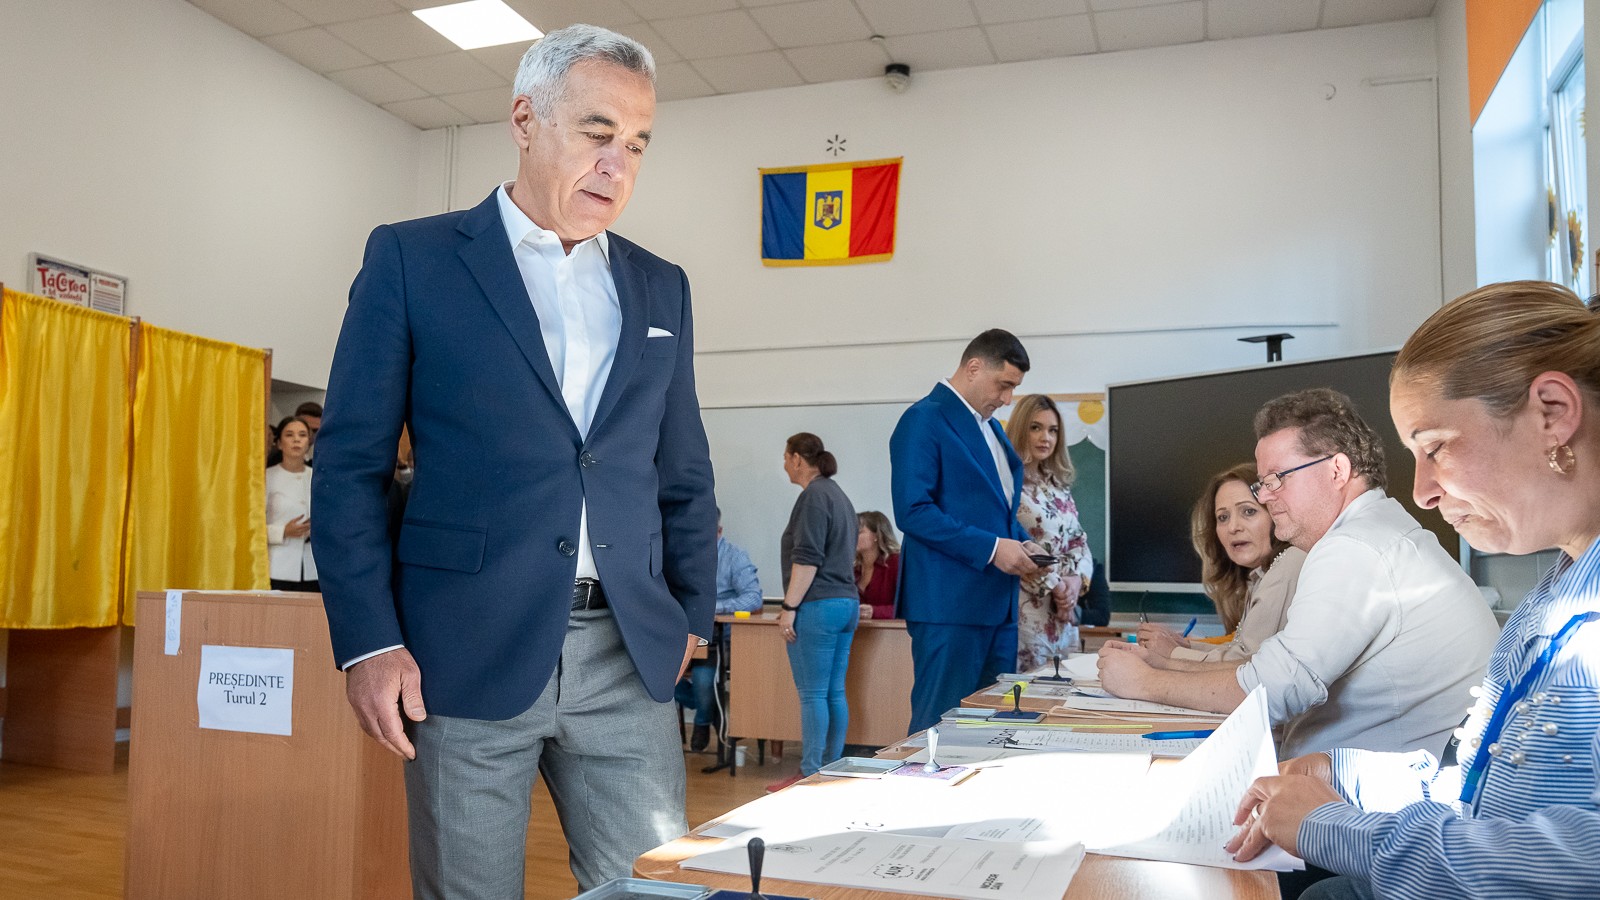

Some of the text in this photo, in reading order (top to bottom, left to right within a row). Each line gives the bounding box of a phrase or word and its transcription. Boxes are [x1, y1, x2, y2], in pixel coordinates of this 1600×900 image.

[208, 671, 285, 690] PREȘEDINTE
[223, 690, 267, 706] Turul 2
